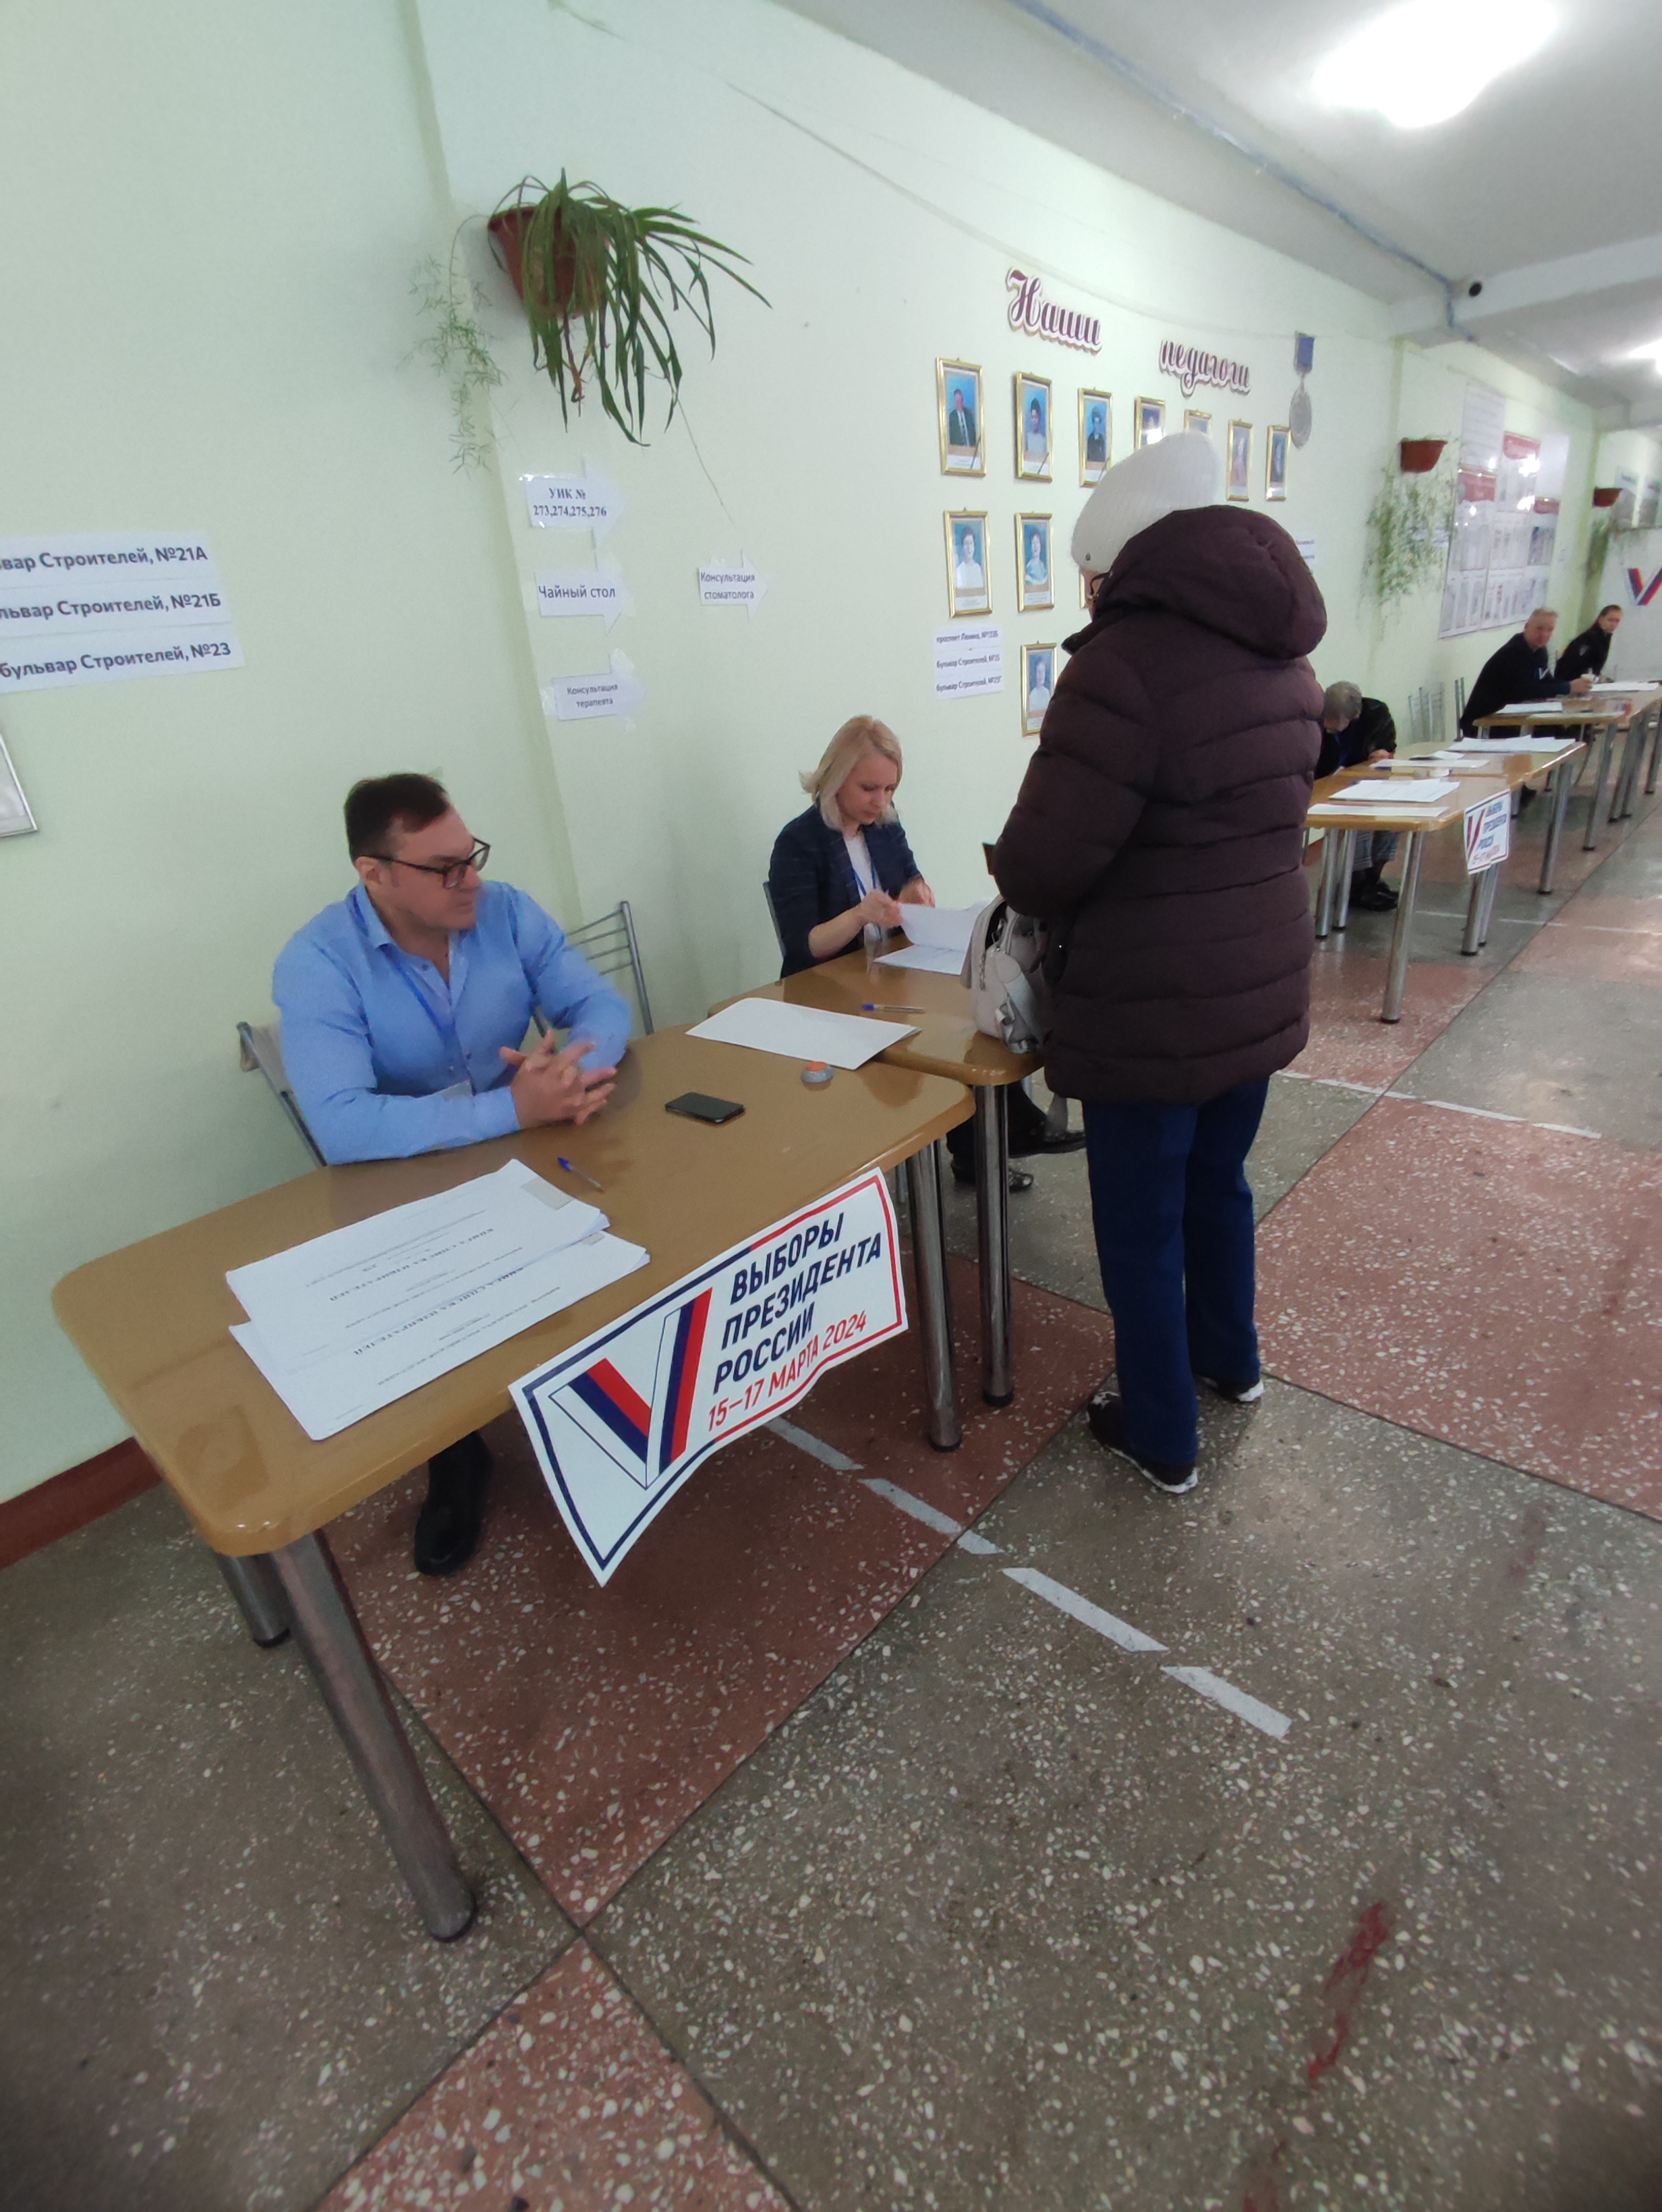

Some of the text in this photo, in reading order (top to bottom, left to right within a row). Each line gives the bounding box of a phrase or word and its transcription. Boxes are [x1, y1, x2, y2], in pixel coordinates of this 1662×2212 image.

[1006, 268, 1101, 352] Наши
[575, 489, 586, 500] №
[39, 548, 154, 570] Строителей,
[155, 546, 208, 562] №21А
[700, 571, 755, 585] Консультация
[538, 584, 615, 599] Чайный стол
[704, 589, 754, 600] стоматолога
[57, 596, 169, 617] Строителей,
[171, 593, 221, 608] №21Б
[0, 642, 231, 680] бульвар Строителей, №23
[567, 683, 619, 697] Консультация
[576, 697, 614, 709] терапевта
[730, 1212, 844, 1306] ВЫБОРЫ
[720, 1232, 882, 1351] ПРЕЗИДЕНТА
[713, 1302, 815, 1395] РОССИИ
[768, 1334, 819, 1397] МАРТА
[822, 1310, 867, 1351] 2024
